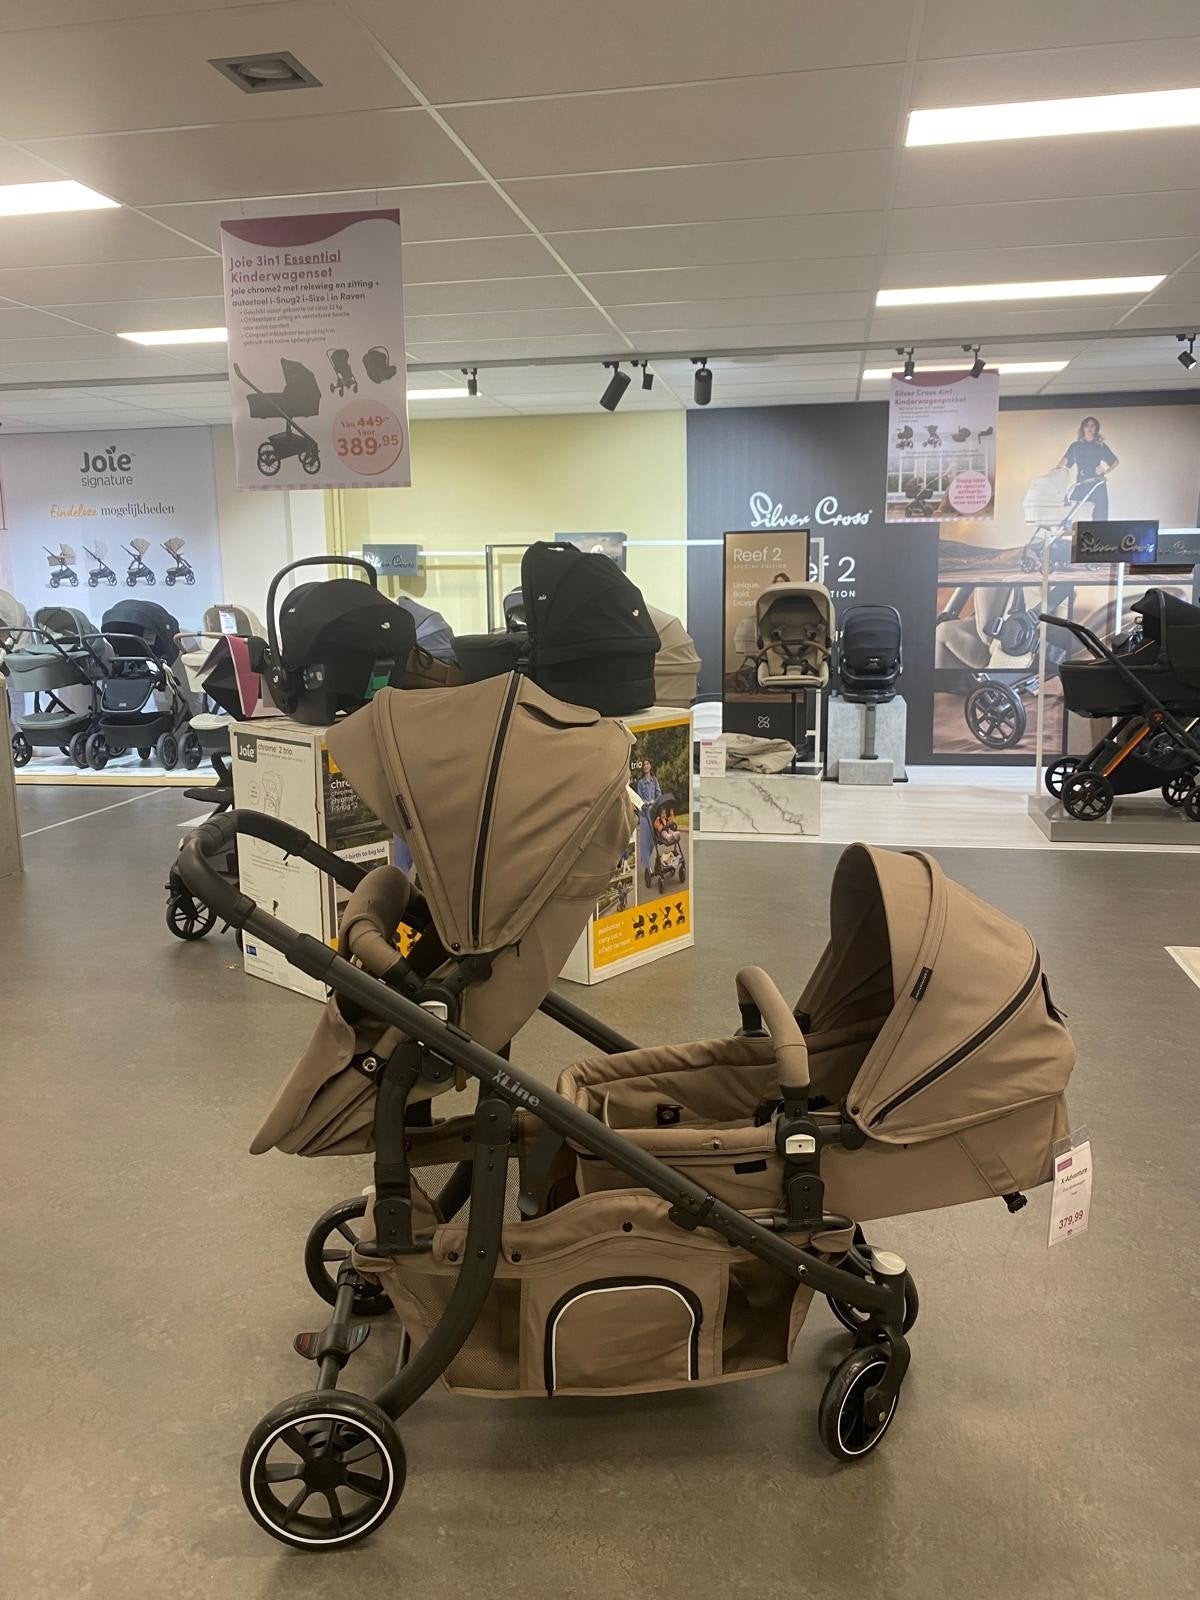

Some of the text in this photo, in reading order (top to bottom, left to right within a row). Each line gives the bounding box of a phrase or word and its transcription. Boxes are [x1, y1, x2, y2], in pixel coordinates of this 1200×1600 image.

[229, 250, 342, 272] Joie 3in1 Essential
[231, 267, 333, 284] Kinderwagenset
[231, 287, 245, 297] Joie
[247, 284, 281, 294] chrome2
[283, 284, 298, 292] met
[300, 282, 334, 293] reiswieg
[347, 280, 373, 290] zitting
[231, 297, 269, 307] autostoel
[330, 293, 339, 301] in
[340, 291, 366, 301] Raven
[337, 434, 399, 457] 389,95
[79, 446, 132, 474] Joie
[81, 474, 134, 489] signature
[50, 502, 176, 519] Eindeloze mogelijkheden
[750, 491, 872, 528] Silver Cross
[1081, 530, 1119, 553] Silver
[1120, 534, 1155, 553] Cross
[733, 547, 783, 562] Reef 2
[837, 556, 856, 583] 2
[830, 589, 857, 598] TION
[239, 743, 256, 758] Joie
[257, 743, 277, 754] chrome
[278, 745, 283, 754] 2
[283, 747, 294, 756] trio
[630, 760, 643, 770] trio
[492, 1069, 540, 1107] XLine
